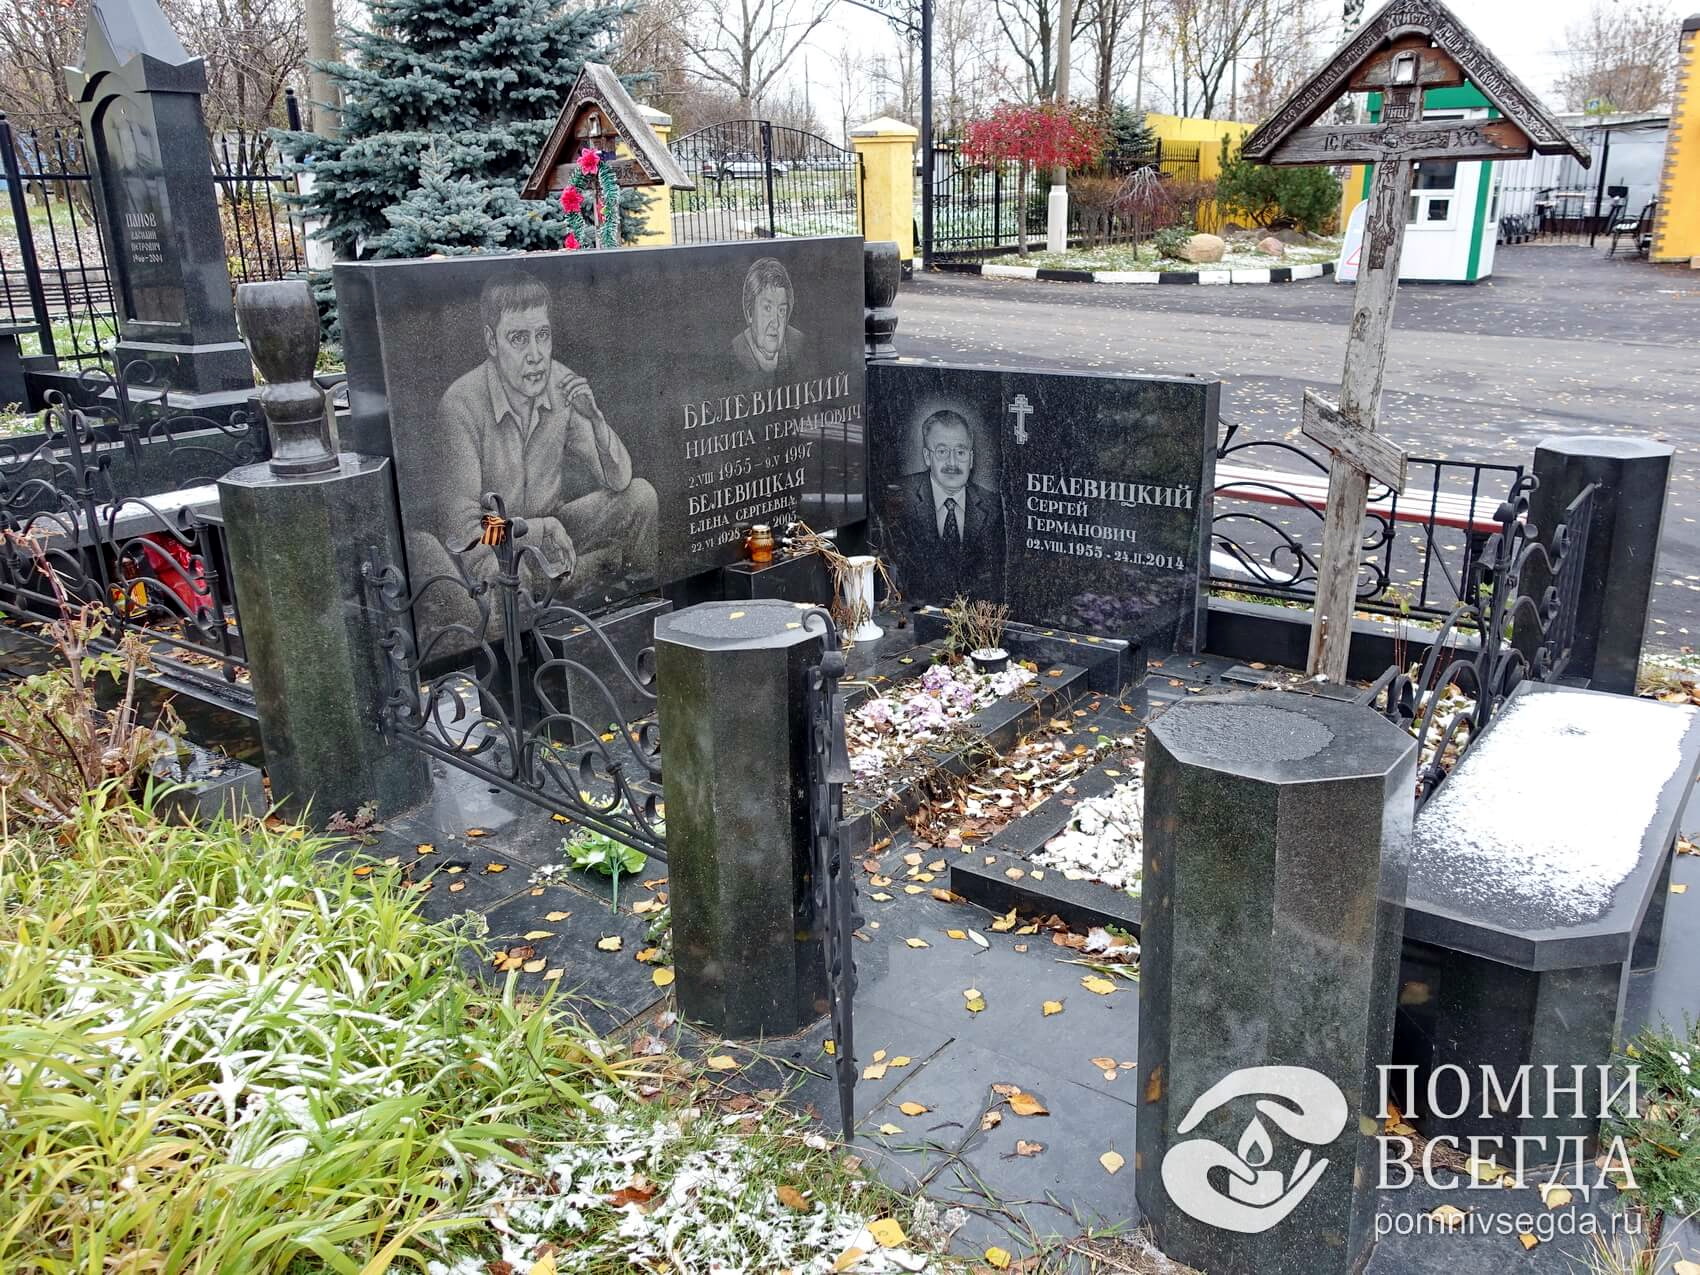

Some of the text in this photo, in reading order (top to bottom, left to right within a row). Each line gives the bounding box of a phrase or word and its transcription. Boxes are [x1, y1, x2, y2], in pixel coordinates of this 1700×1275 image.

[125, 212, 157, 228] ПАНОВ
[682, 370, 849, 430] БЕЛЕВИЦКИЙ
[686, 403, 861, 460] НИКИТА ГЕРМАНОВИЧ
[719, 457, 752, 481] 1955
[785, 441, 814, 464] 1997
[688, 467, 806, 516] БЕЛЕВИЦКАЯ
[1026, 473, 1193, 509] БЕЛЕВИЦКИЙ
[1026, 496, 1088, 517] СЕРГЕЙ
[690, 513, 730, 535] ЕЛЕНА
[735, 495, 798, 521] СЕРГЕЕВНА
[1026, 515, 1137, 543] ГЕРМАНОВИЧ
[1026, 538, 1103, 559] 02.VIII.1955
[1114, 550, 1185, 571] 24.II.2014
